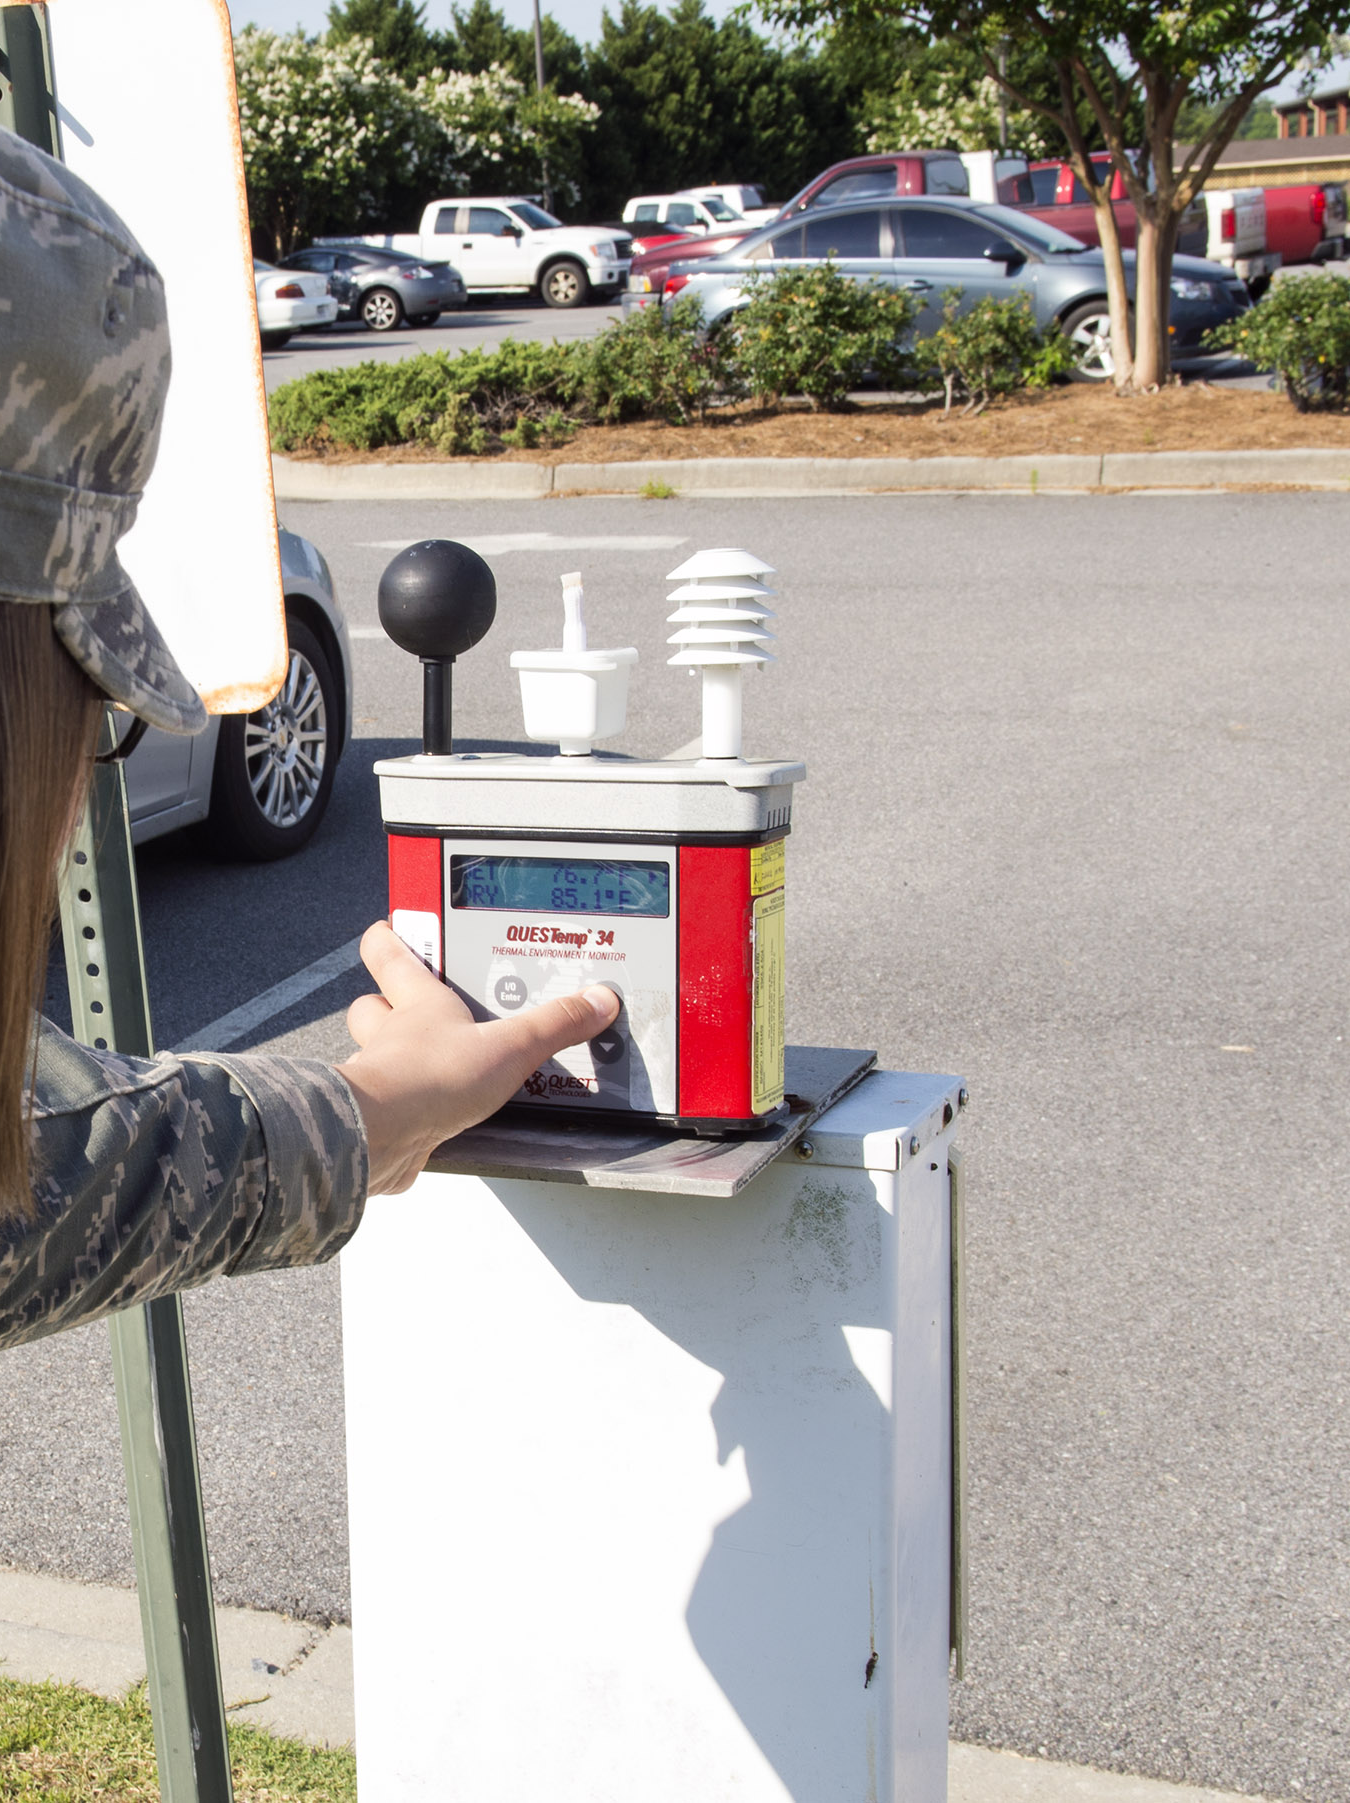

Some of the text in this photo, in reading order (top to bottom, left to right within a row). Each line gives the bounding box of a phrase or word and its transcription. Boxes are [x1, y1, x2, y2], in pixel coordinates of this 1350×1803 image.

[595, 929, 615, 946] 34
[492, 946, 626, 961] THERMAL ENVIRONMENT MONITOR
[504, 981, 517, 992] I/O
[500, 991, 522, 1003] Enter
[548, 1074, 593, 1090] QUEST
[549, 1088, 592, 1098] TECHNOLOGIES
